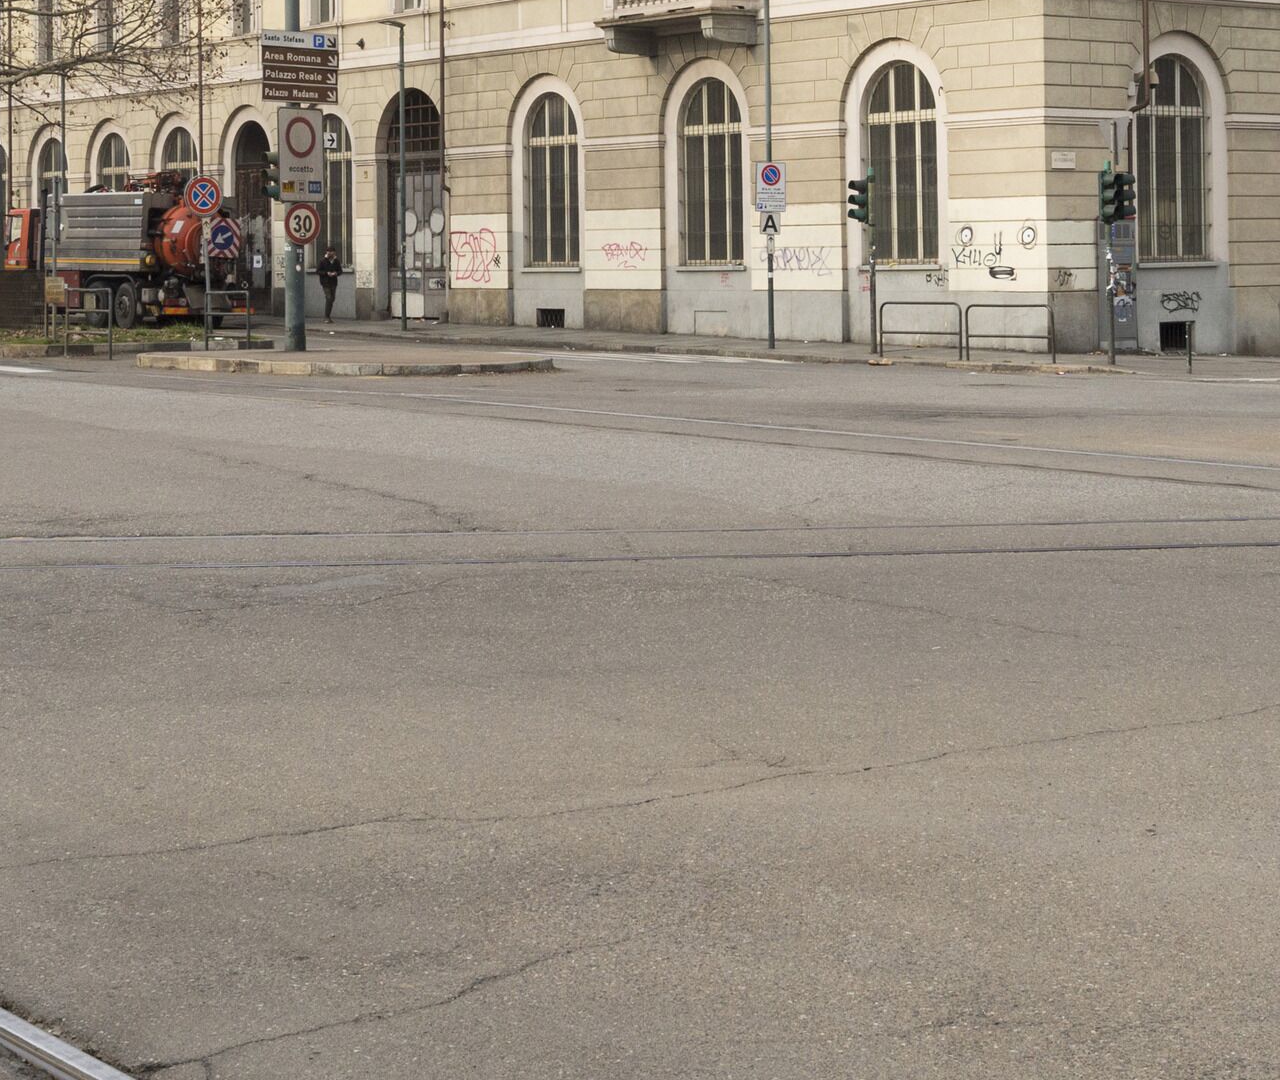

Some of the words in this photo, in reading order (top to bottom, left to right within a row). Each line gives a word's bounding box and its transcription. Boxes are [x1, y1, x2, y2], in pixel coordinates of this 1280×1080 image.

[264, 51, 284, 61] Area
[286, 52, 321, 63] Romana
[265, 69, 296, 80] Palazzo
[299, 71, 322, 81] Reale
[264, 88, 288, 97] Palazzo
[292, 89, 319, 98] Madama
[293, 215, 312, 233] 30
[762, 214, 778, 232] A
